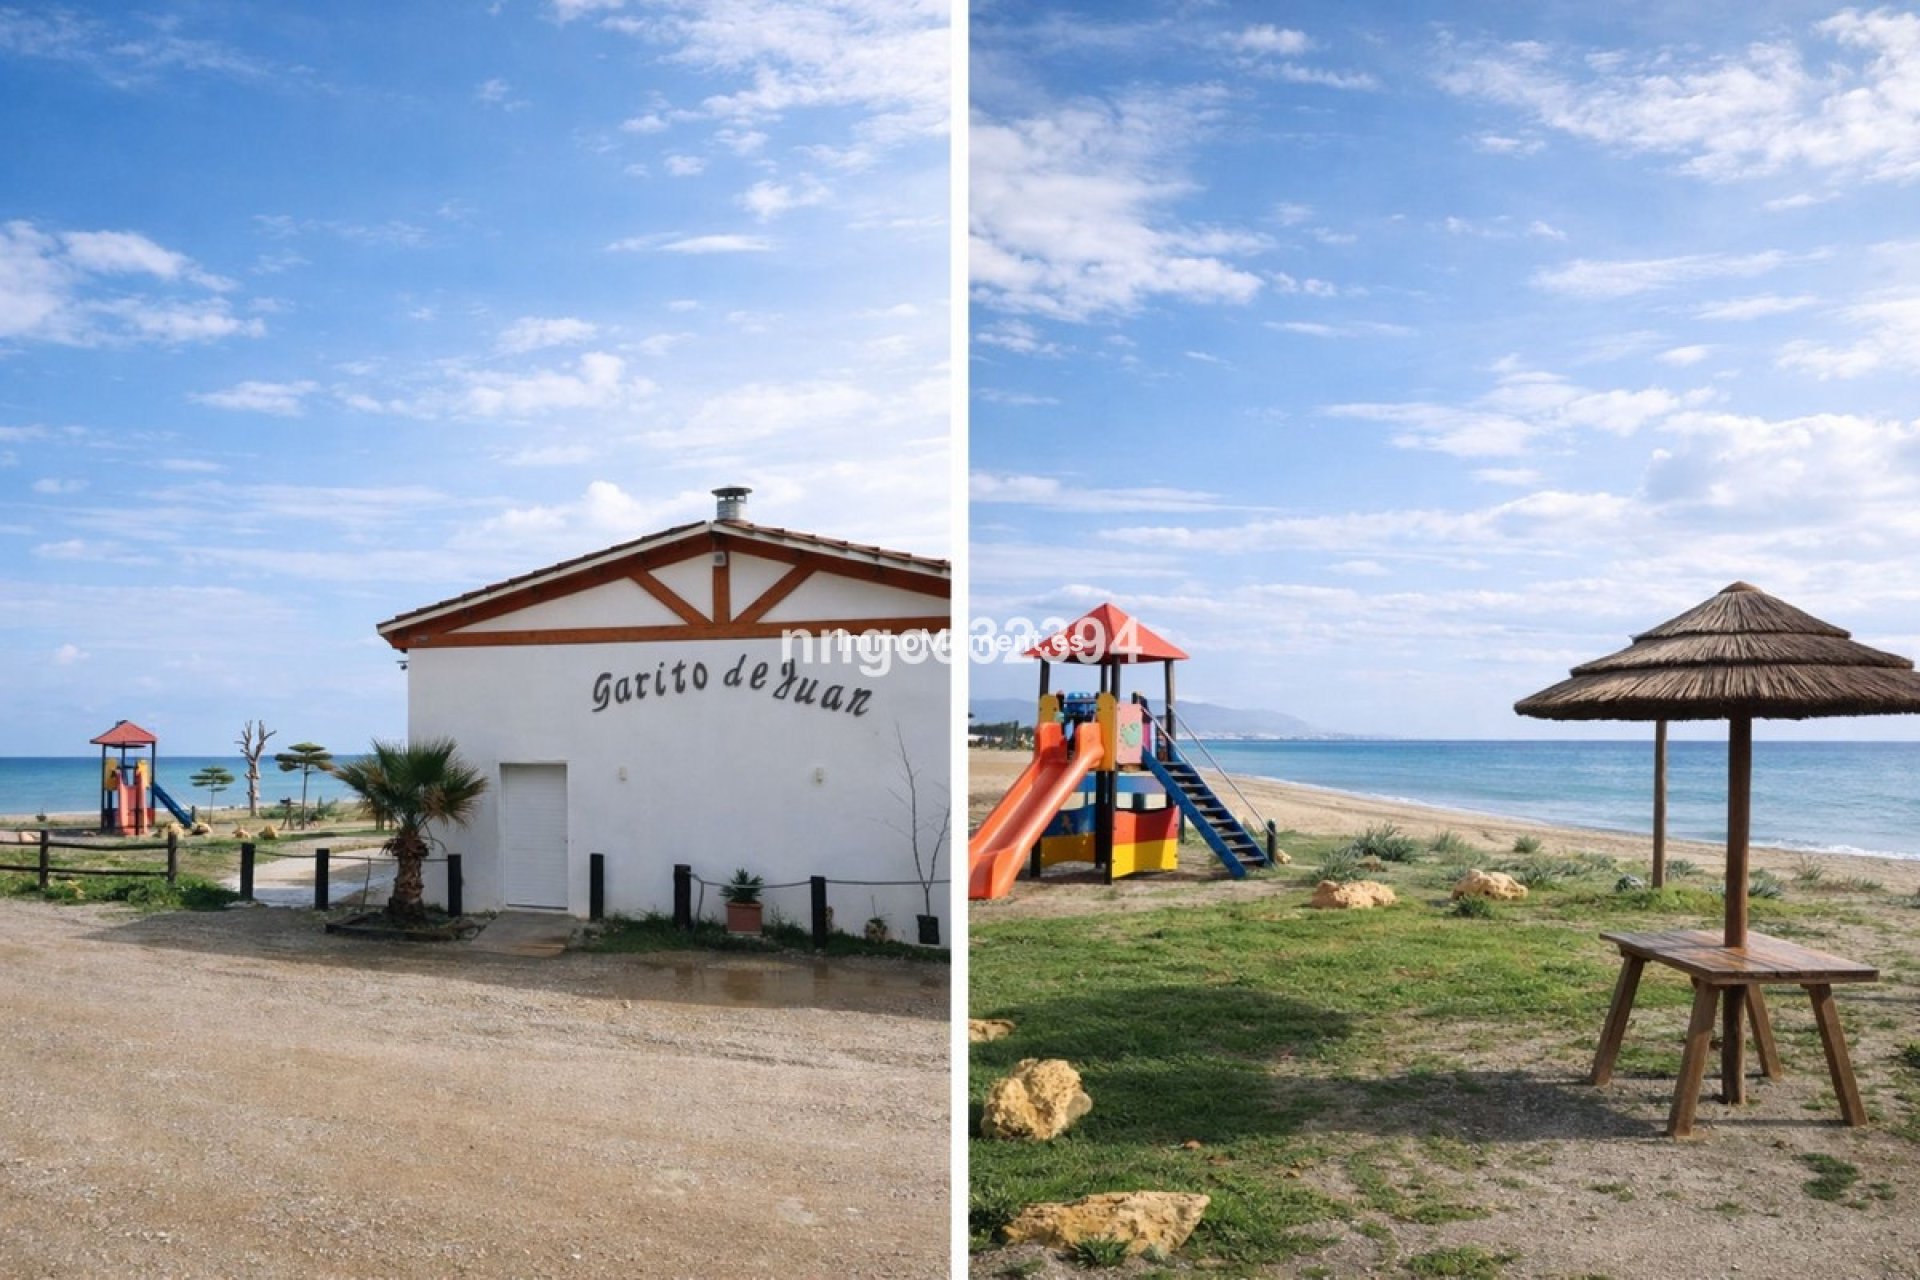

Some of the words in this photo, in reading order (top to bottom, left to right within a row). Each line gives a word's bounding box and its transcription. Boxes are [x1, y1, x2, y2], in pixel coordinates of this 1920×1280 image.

[592, 661, 708, 712] Garito
[723, 653, 769, 689] de
[772, 658, 872, 717] Juan
